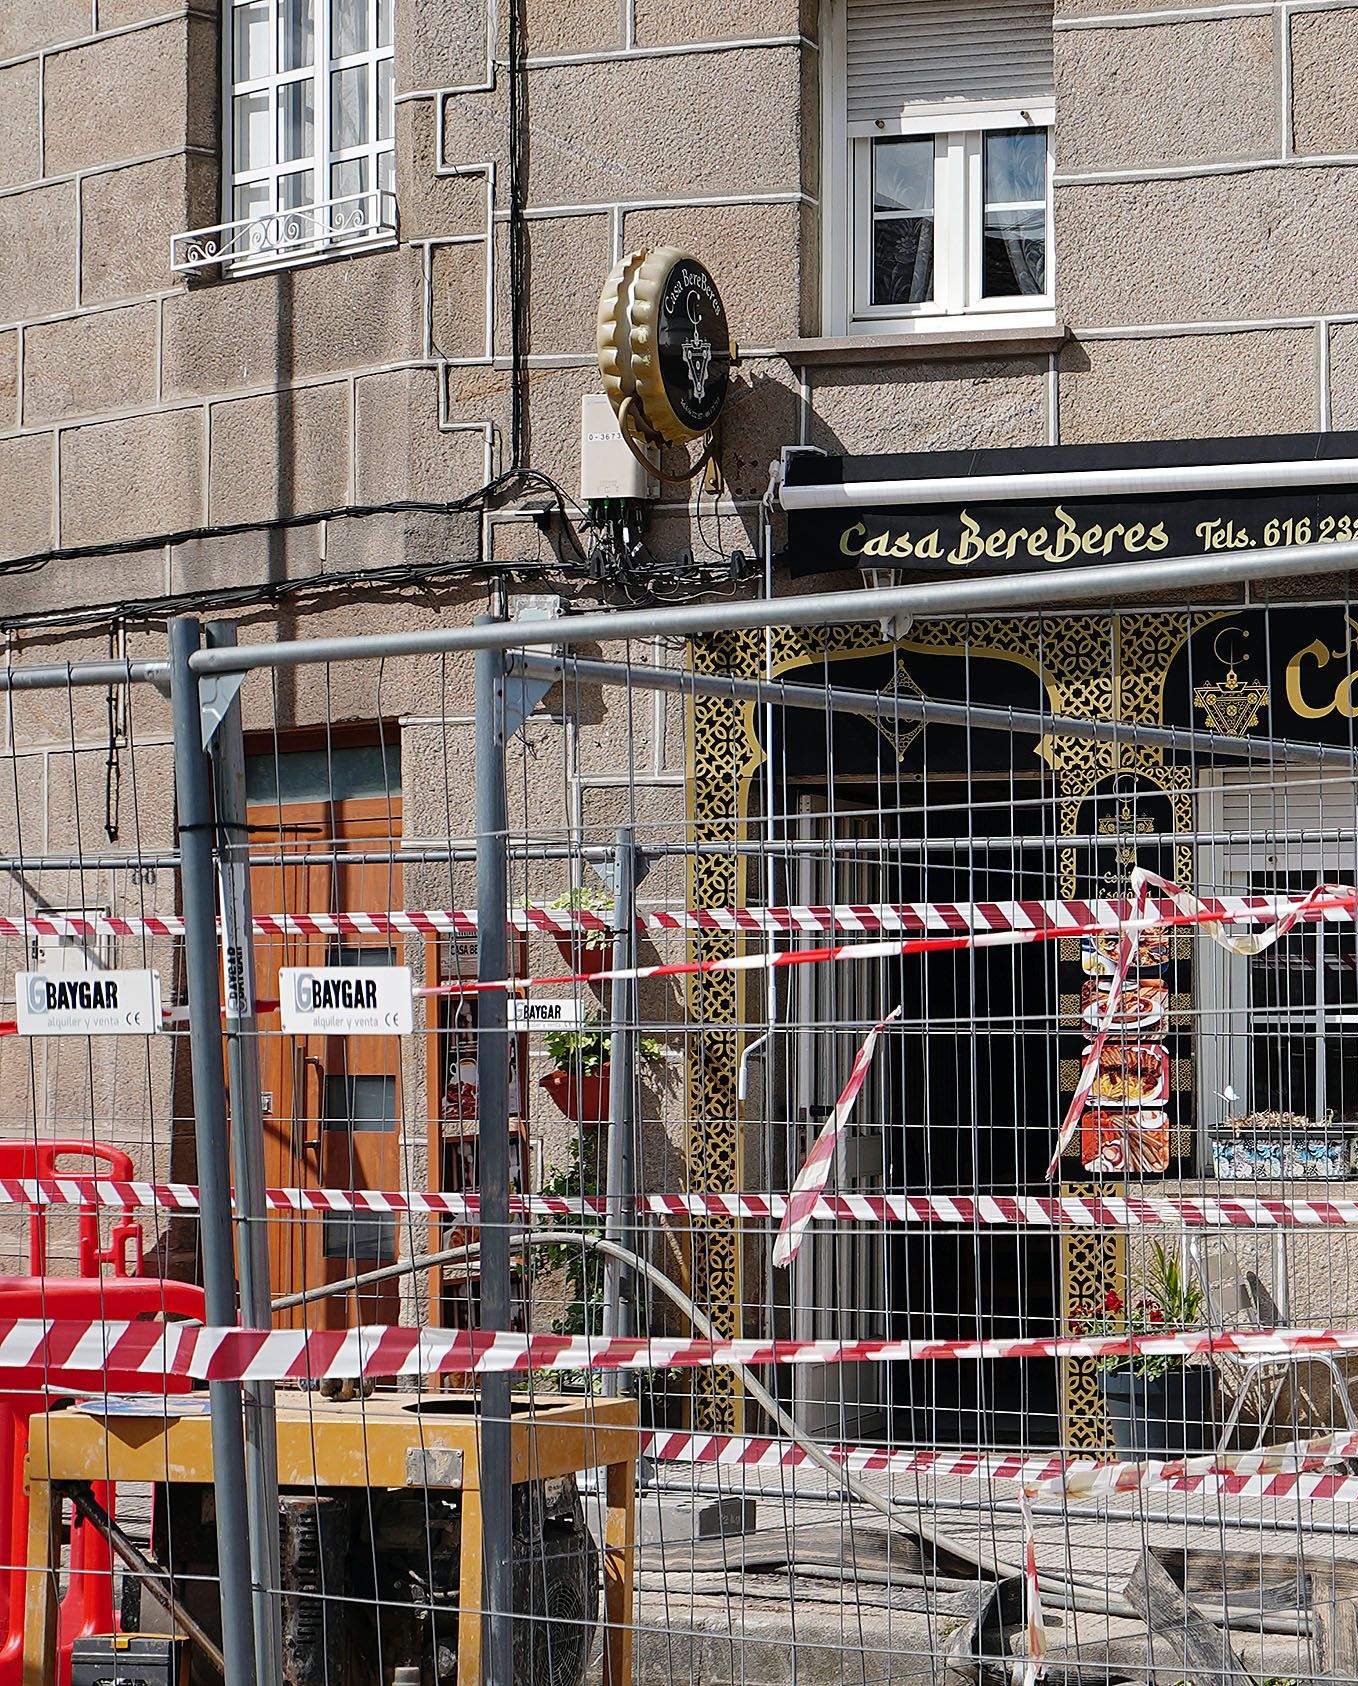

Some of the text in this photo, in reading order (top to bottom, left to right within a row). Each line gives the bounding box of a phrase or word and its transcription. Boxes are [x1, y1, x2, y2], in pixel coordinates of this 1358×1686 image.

[665, 268, 721, 316] Casa BereBeres
[839, 522, 944, 557] Casa
[946, 504, 1170, 565] BereBeres
[1195, 517, 1257, 551] Tels.
[1263, 517, 1312, 546] 616
[46, 980, 118, 1010] BAYGAR
[312, 979, 377, 1009] BAYGAR
[48, 1016, 80, 1029] alquiler
[94, 1016, 119, 1027] venta
[313, 1015, 344, 1029] alquiler
[354, 1016, 378, 1027] venta
[523, 1004, 561, 1020] BAYGAR
